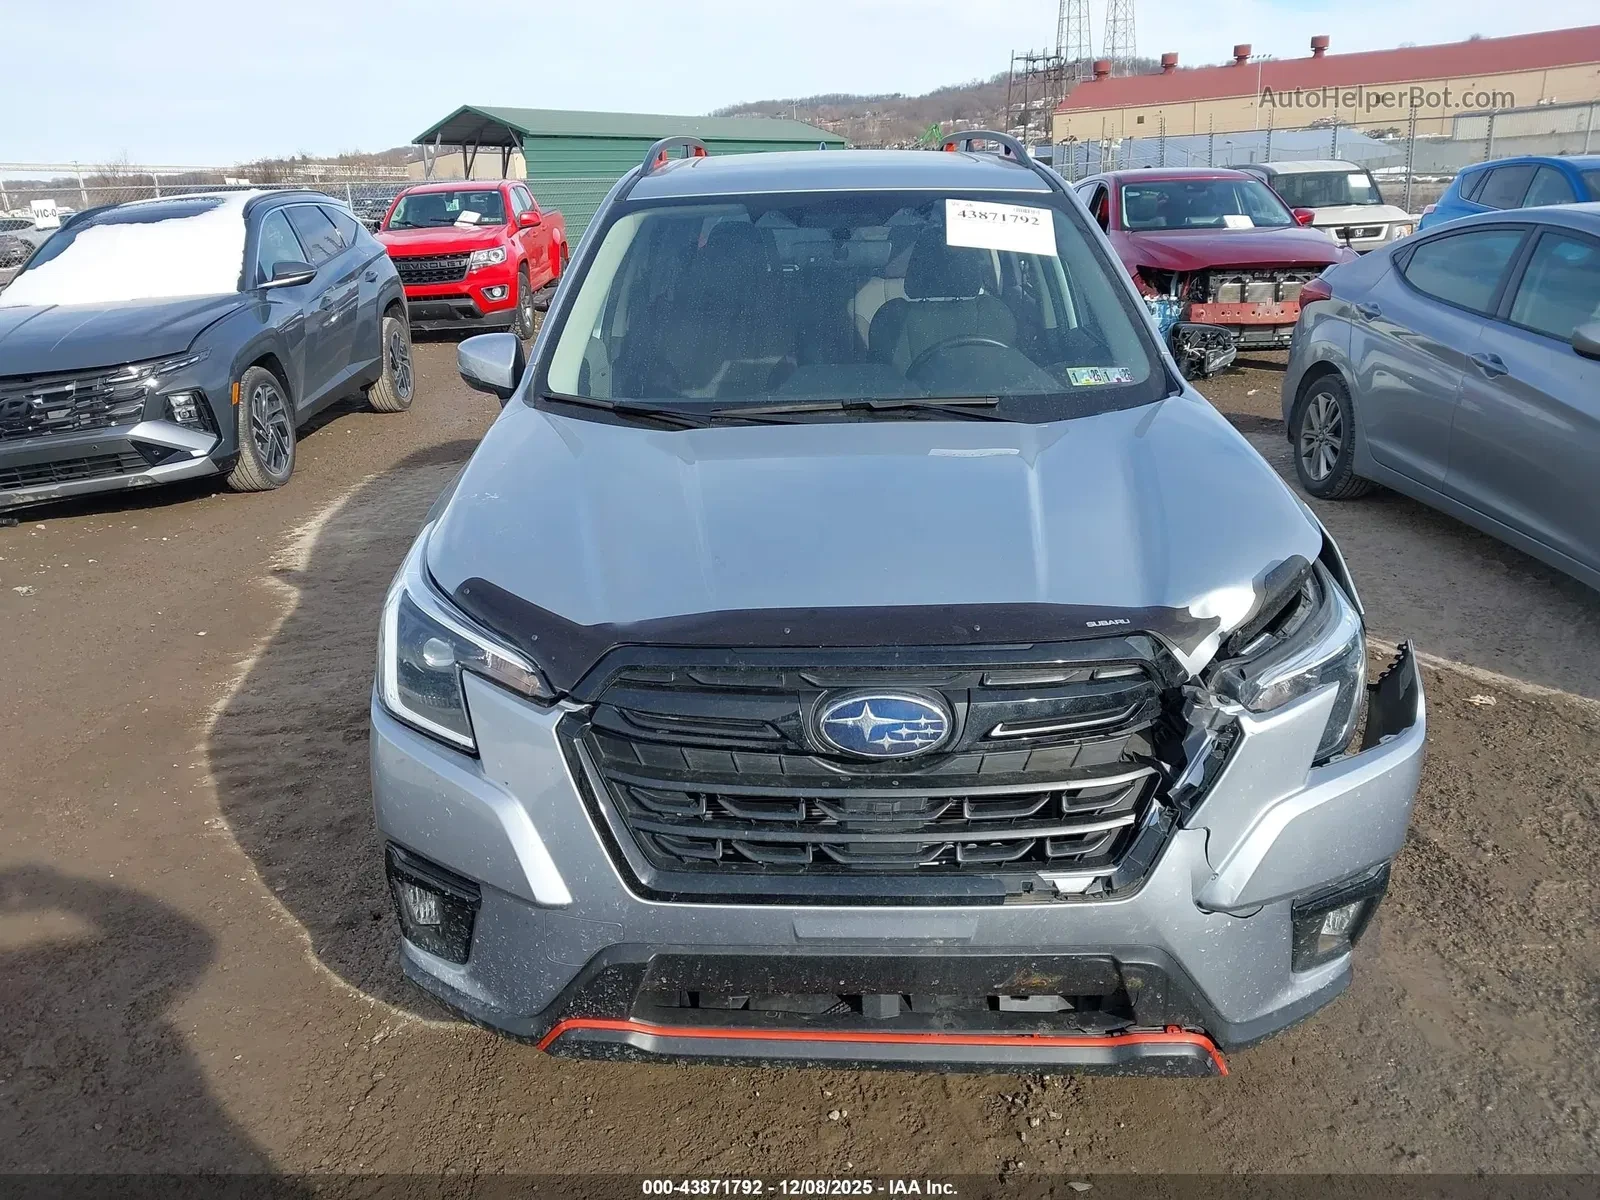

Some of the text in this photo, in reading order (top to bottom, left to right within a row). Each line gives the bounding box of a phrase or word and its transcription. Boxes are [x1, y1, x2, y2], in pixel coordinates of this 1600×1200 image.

[957, 210, 1040, 226] 43871792
[396, 259, 465, 271] HEVROLET
[1085, 618, 1131, 628] SUBARU
